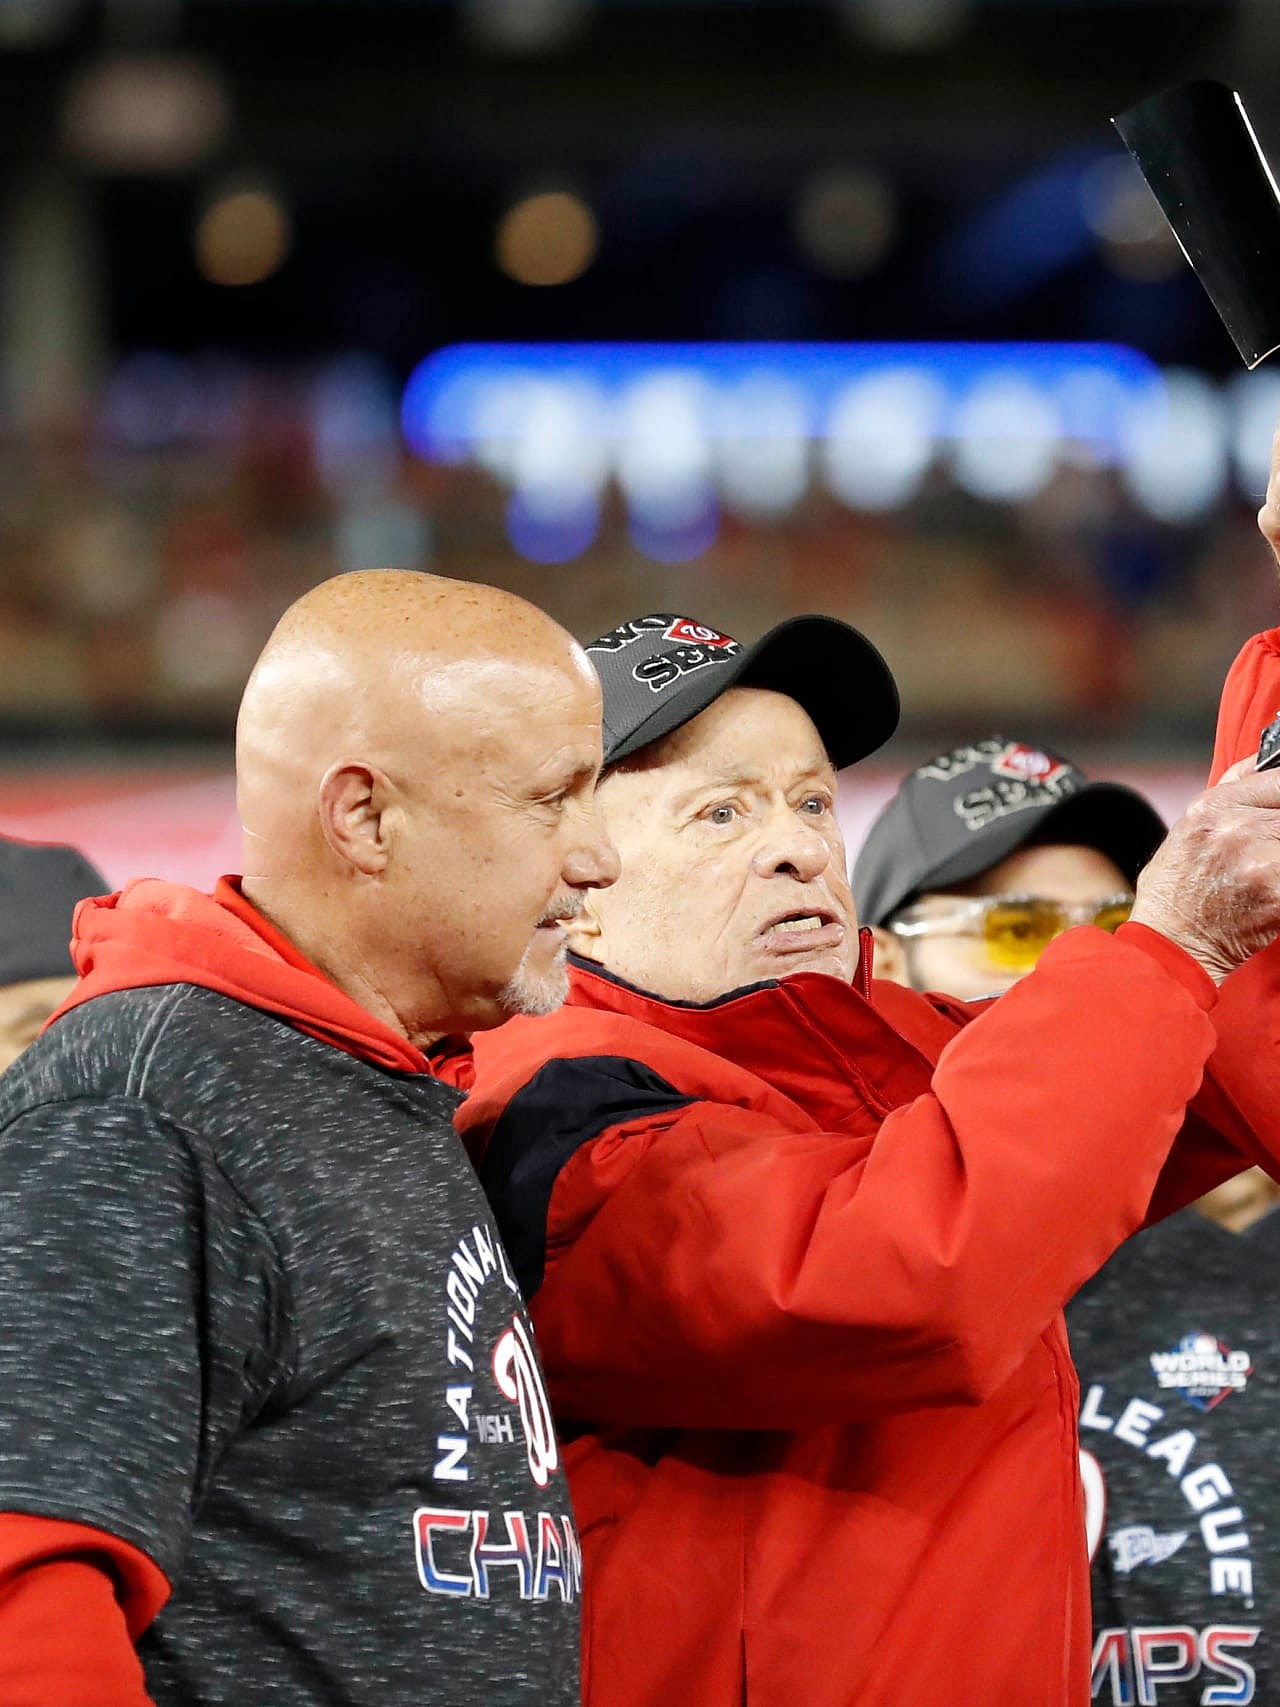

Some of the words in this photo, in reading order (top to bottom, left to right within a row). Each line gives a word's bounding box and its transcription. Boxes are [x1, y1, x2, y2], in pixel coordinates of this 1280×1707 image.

[1150, 1350, 1251, 1372] WORLD
[1157, 1371, 1248, 1388] SERIES
[1079, 1383, 1254, 1597] LEAGUE
